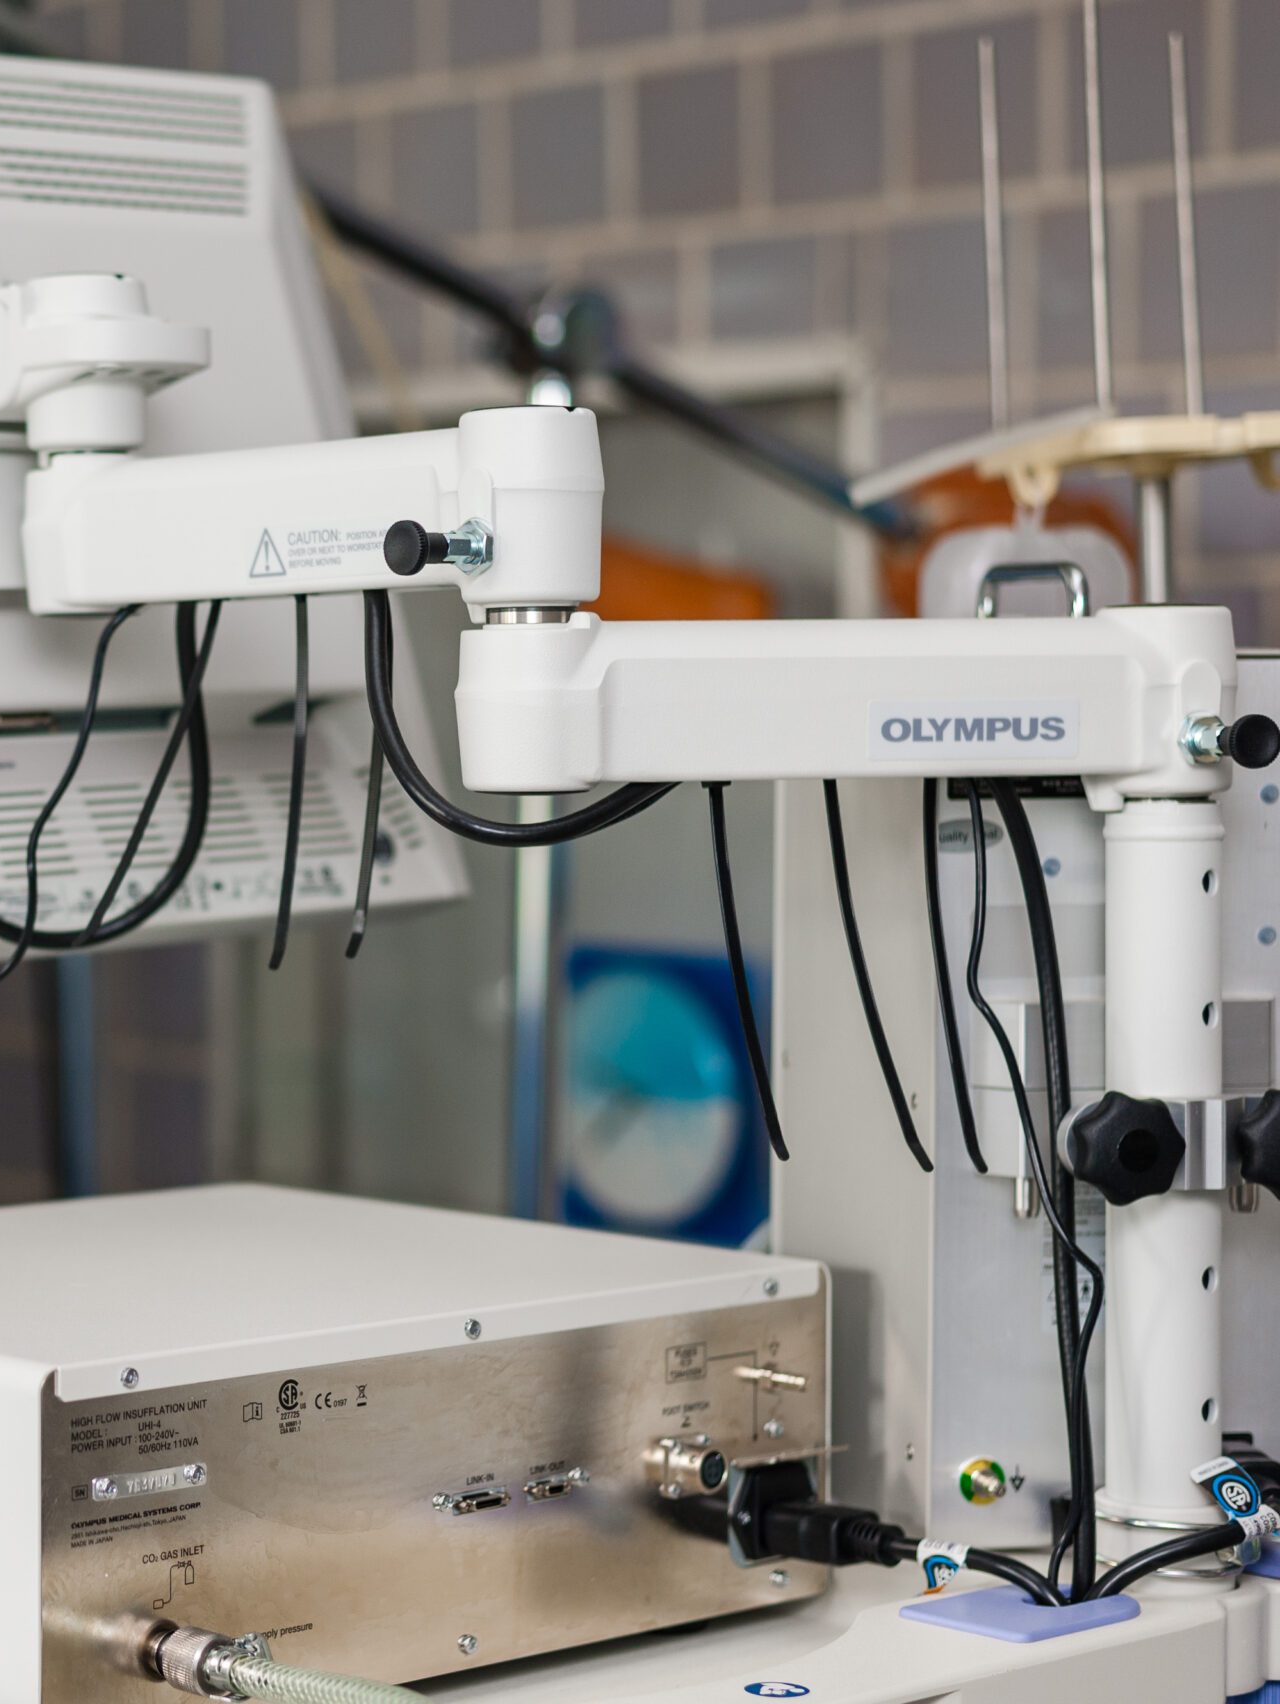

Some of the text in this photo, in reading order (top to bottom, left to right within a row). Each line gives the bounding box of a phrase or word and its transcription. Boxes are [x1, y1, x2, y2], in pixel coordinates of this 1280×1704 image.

[288, 530, 341, 545] CAUTION:
[881, 716, 1065, 742] OLYMPUS
[938, 830, 969, 845] uality
[333, 1398, 348, 1408] 0197
[70, 1399, 207, 1428] HIGH FLOW INSUFFLATION UNIT
[280, 1411, 300, 1420] 227725
[71, 1430, 103, 1442] MODEL
[138, 1420, 161, 1432] UHI-4
[71, 1440, 104, 1454] POWER
[106, 1435, 133, 1448] INPUT
[138, 1436, 199, 1455] 50/60Hz 110VA
[529, 1460, 565, 1475] LINK-OUT
[466, 1473, 495, 1486] LINK-IN
[71, 1517, 107, 1530] OLYMPUS
[108, 1512, 142, 1524] MEDICAL
[143, 1506, 178, 1518] SYSTEMS
[160, 1549, 179, 1561] GAS
[180, 1544, 205, 1558] INLET
[280, 1622, 314, 1637] pressure
